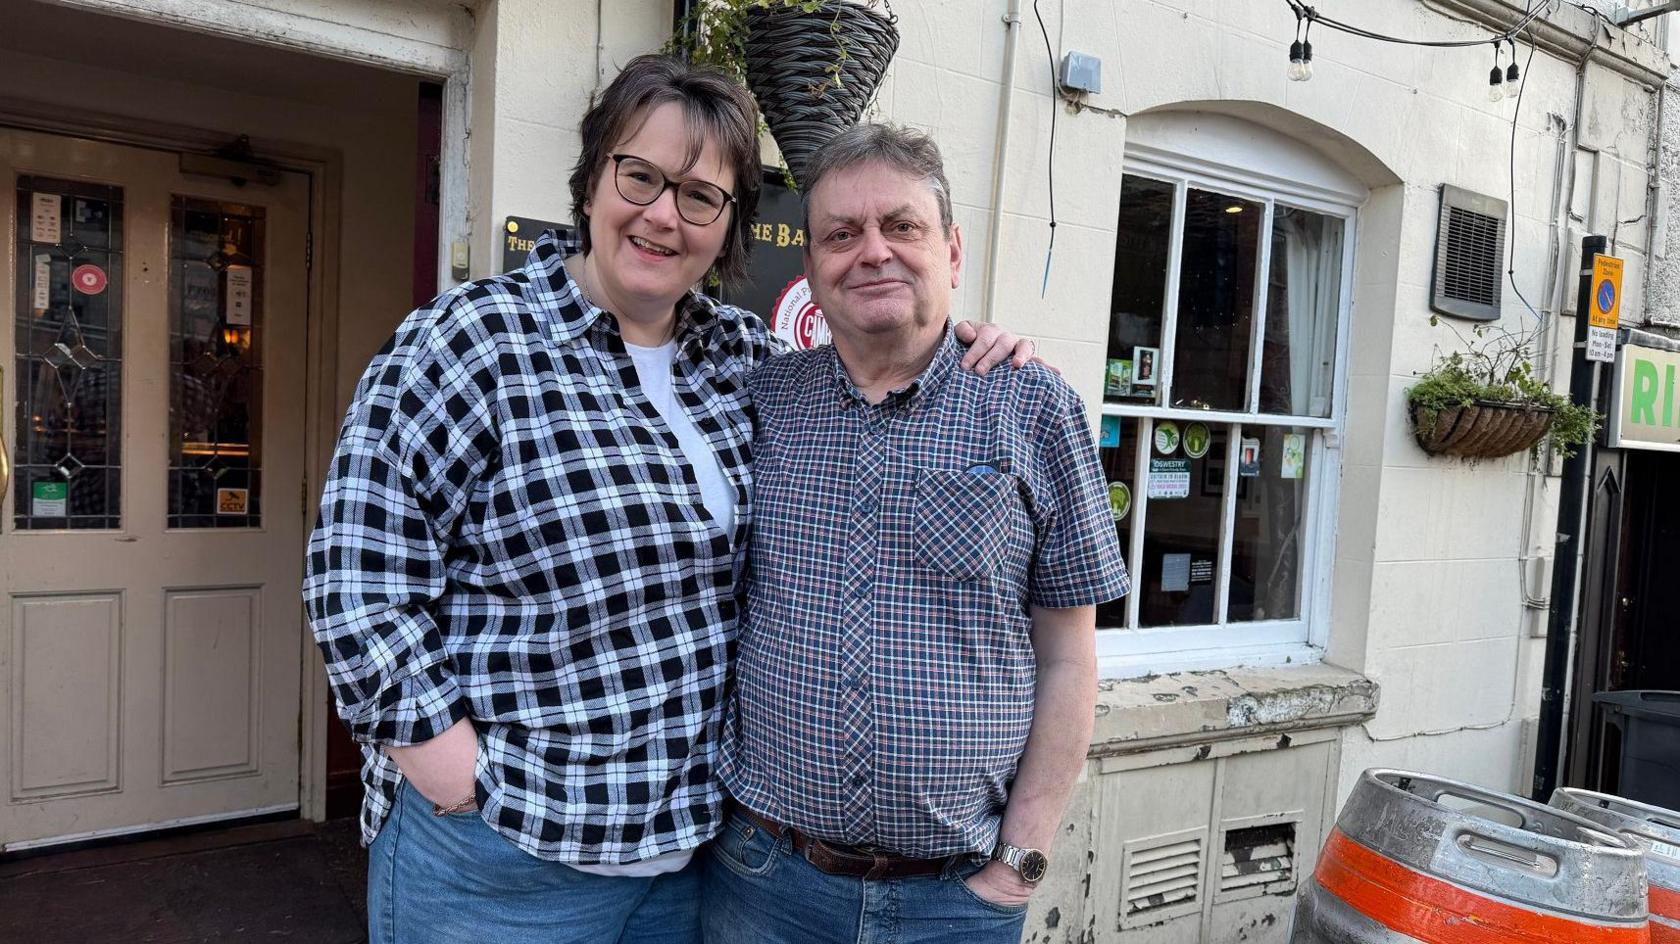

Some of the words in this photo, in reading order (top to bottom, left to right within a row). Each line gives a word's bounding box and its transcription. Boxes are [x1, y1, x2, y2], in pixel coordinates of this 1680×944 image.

[776, 224, 805, 247] BA
[508, 236, 535, 251] THE
[1602, 267, 1613, 276] Zone
[781, 292, 803, 330] National
[1592, 314, 1598, 322] At
[1598, 316, 1606, 325] any
[1592, 329, 1598, 337] No
[1599, 331, 1614, 340] loading
[1631, 358, 1680, 428] RI
[220, 503, 246, 513] CCTV
